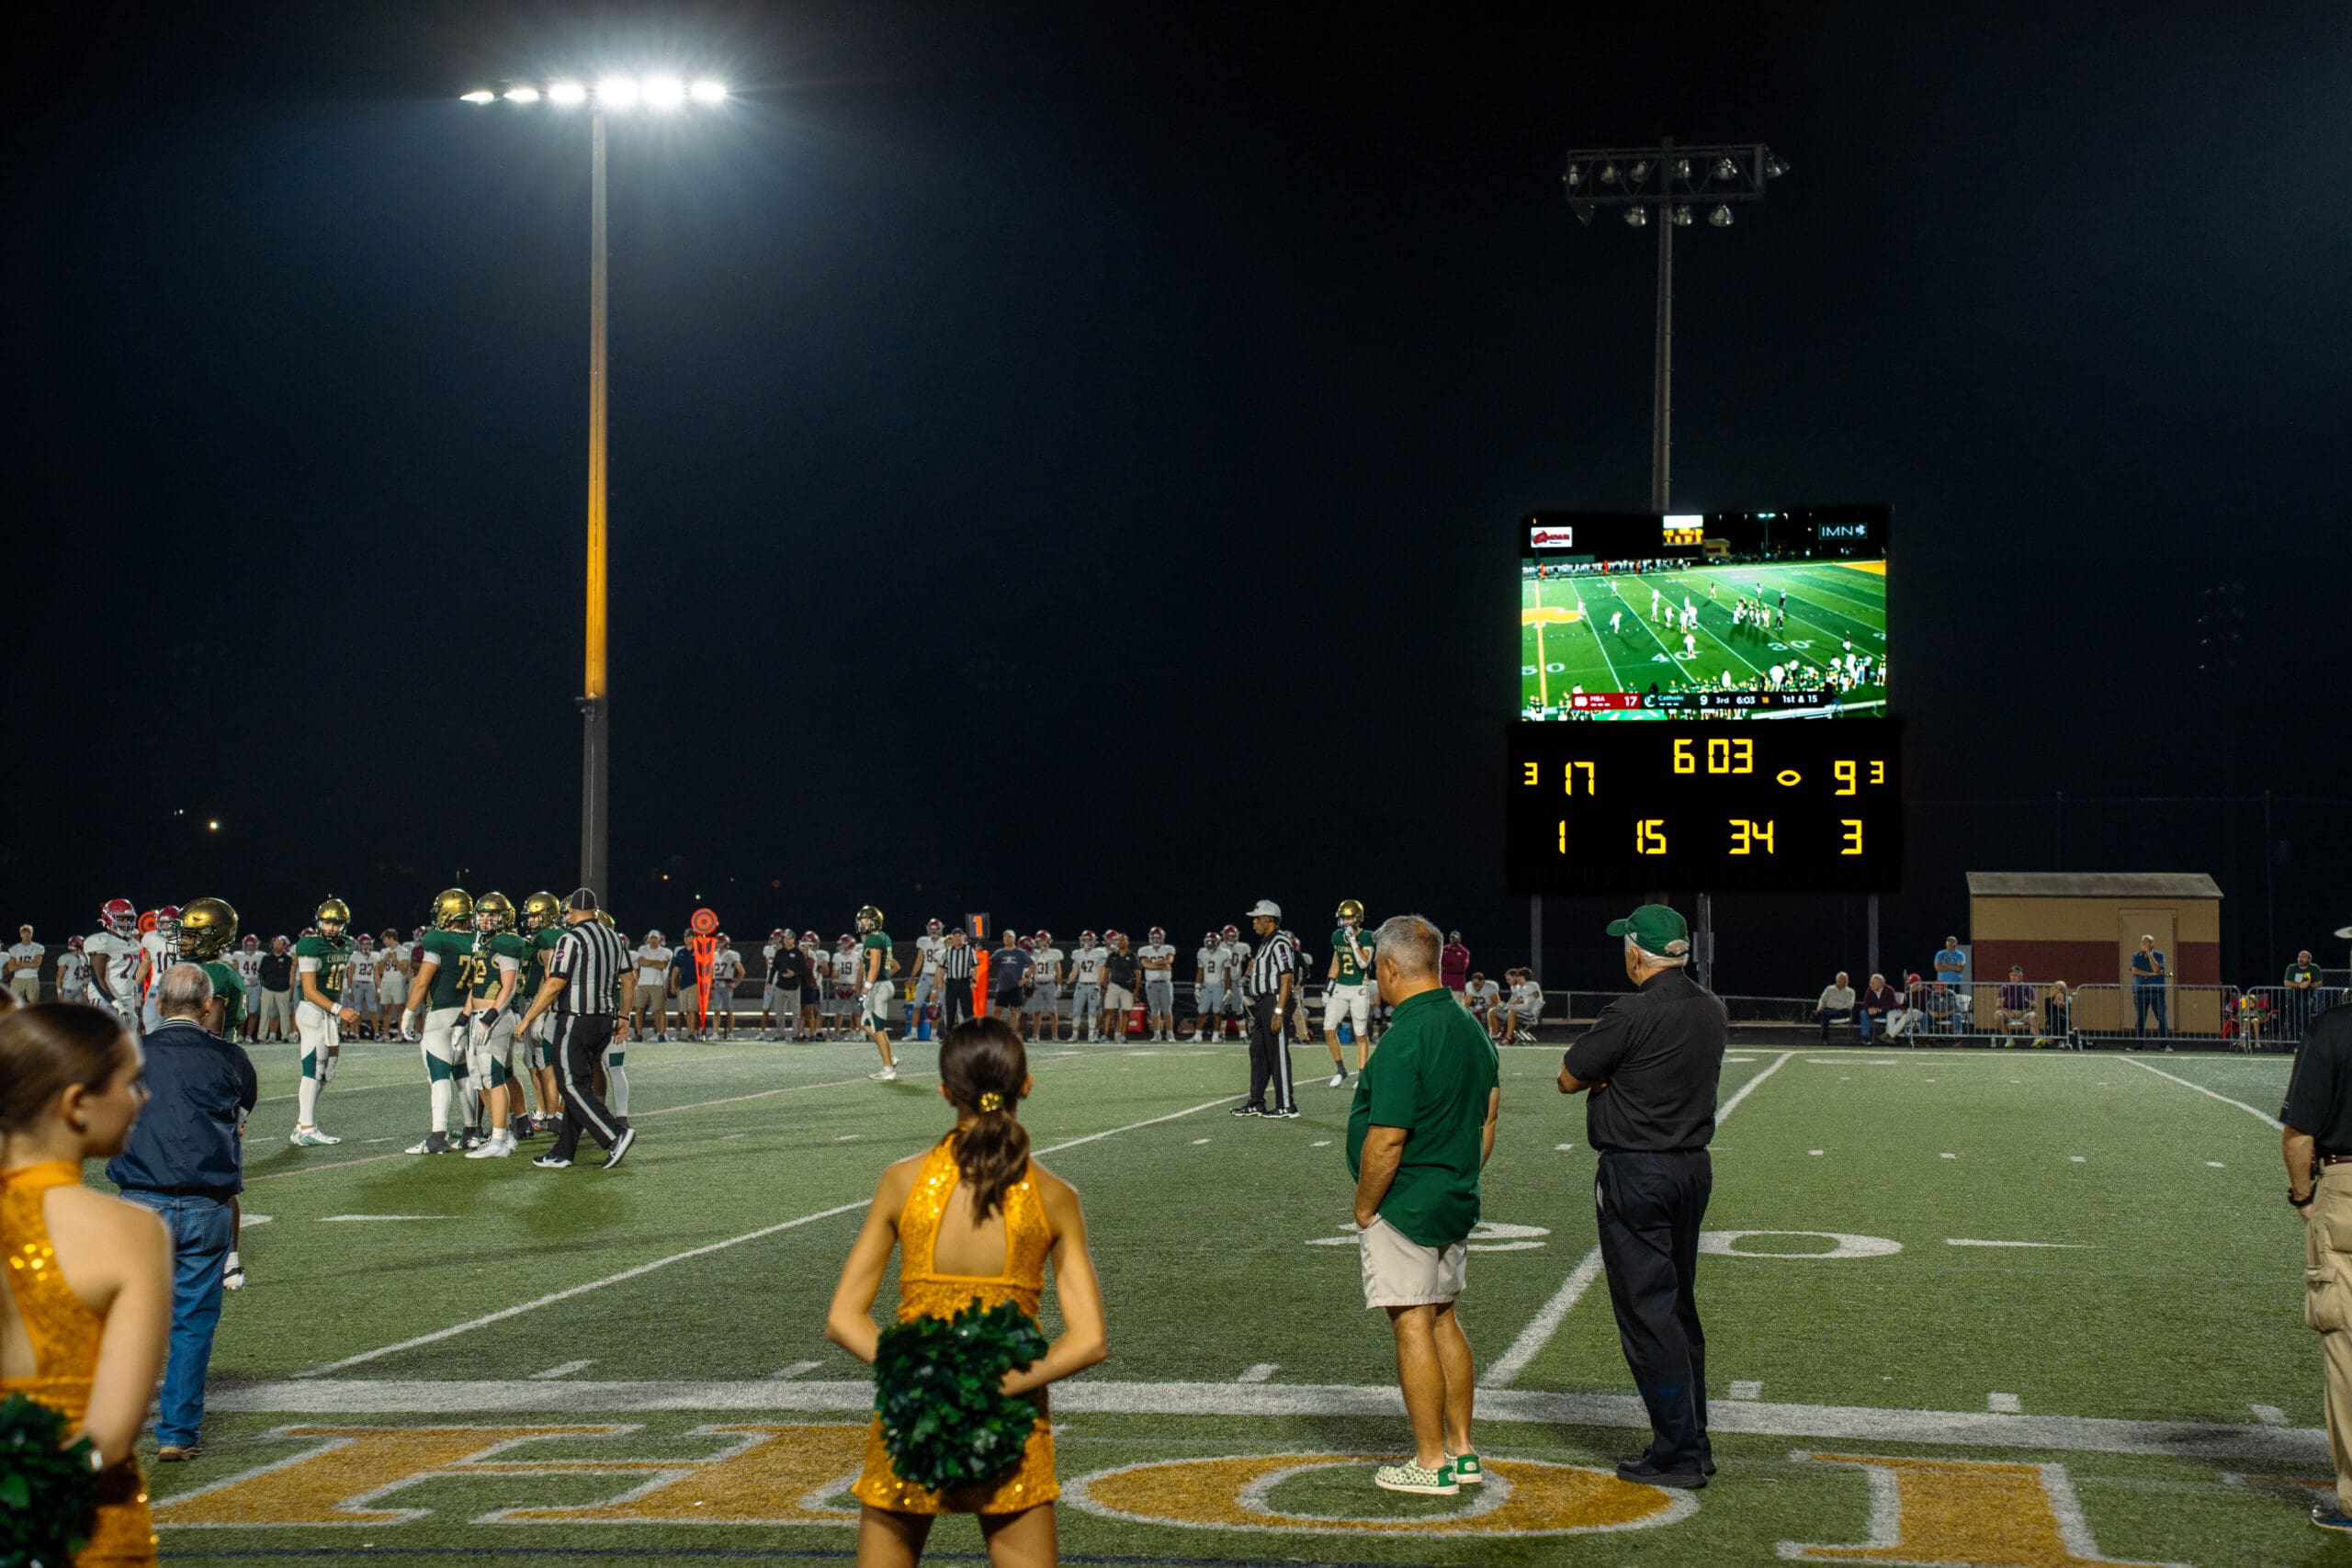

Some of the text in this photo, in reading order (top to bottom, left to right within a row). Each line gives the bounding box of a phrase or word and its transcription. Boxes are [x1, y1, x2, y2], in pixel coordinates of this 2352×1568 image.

[1821, 525, 1853, 536] IMN
[1623, 695, 1638, 707] 17
[1699, 694, 1709, 706] 9
[1715, 695, 1756, 705] 3rd 6:03
[1782, 694, 1818, 704] 1st & 15
[1523, 761, 1538, 785] 3
[1565, 761, 1595, 796] 17
[1834, 760, 1857, 795] 9
[1870, 761, 1884, 784] 3
[1558, 819, 1566, 855] 1
[1636, 819, 1668, 855] 15
[1728, 819, 1775, 855] 34
[1840, 819, 1863, 855] 3
[973, 915, 983, 937] 1
[243, 961, 258, 975] 44
[358, 963, 374, 976] 23
[713, 963, 728, 976] 27
[841, 962, 853, 976] 19
[1080, 960, 1095, 973] 47
[1207, 961, 1216, 974] 2
[1341, 954, 1355, 976] 2
